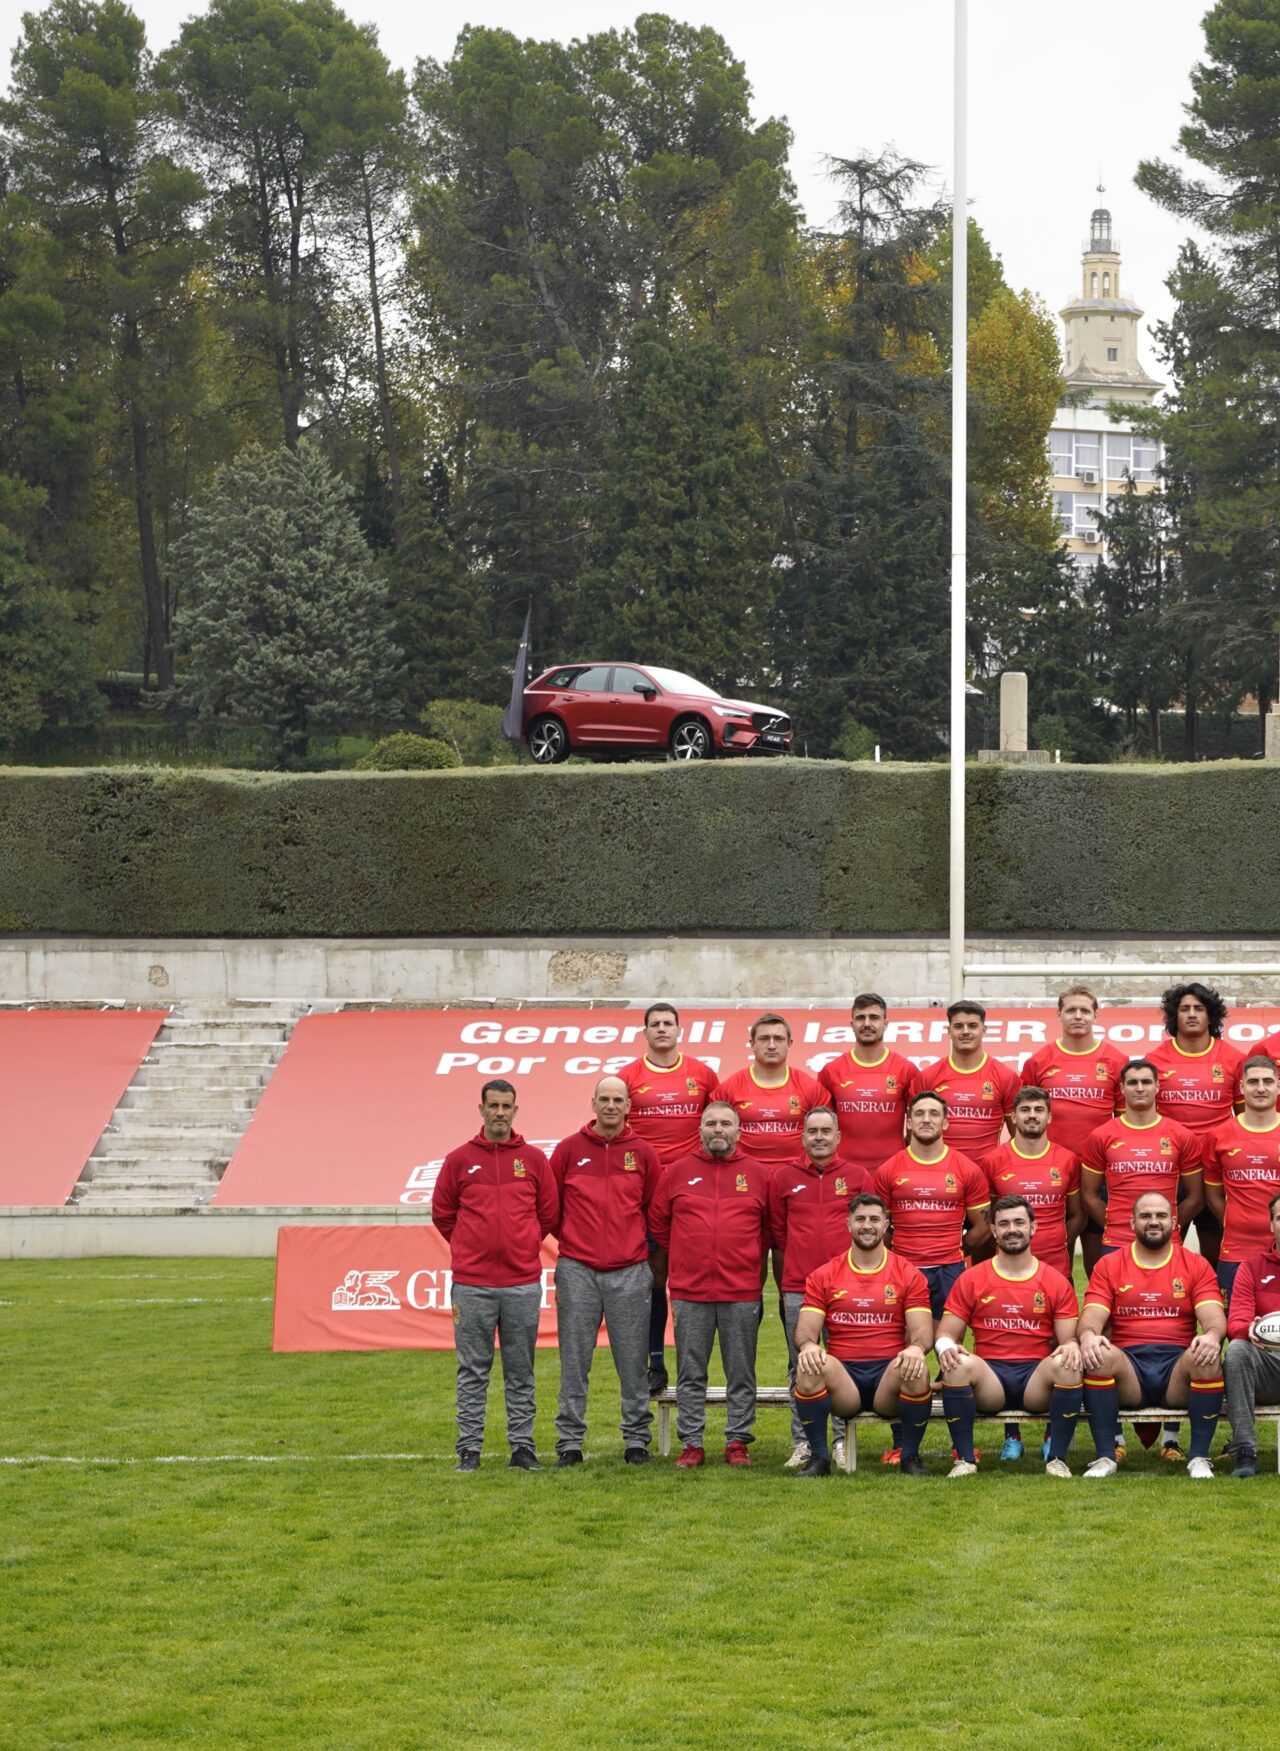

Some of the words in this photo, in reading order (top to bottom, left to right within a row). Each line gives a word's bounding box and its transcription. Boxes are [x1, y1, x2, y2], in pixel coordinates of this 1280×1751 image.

[460, 1021, 726, 1044] Generli
[435, 1053, 546, 1075] Por
[1161, 1089, 1221, 1102] GENERALI
[638, 1103, 700, 1116] GENERALI
[838, 1101, 895, 1113] GENERALI
[741, 1121, 799, 1134] GENERALI
[1111, 1160, 1172, 1173] GENERALI
[831, 1312, 893, 1324] GENERALI
[1117, 1305, 1180, 1318] GENERALI
[984, 1316, 1041, 1330] GENERALI
